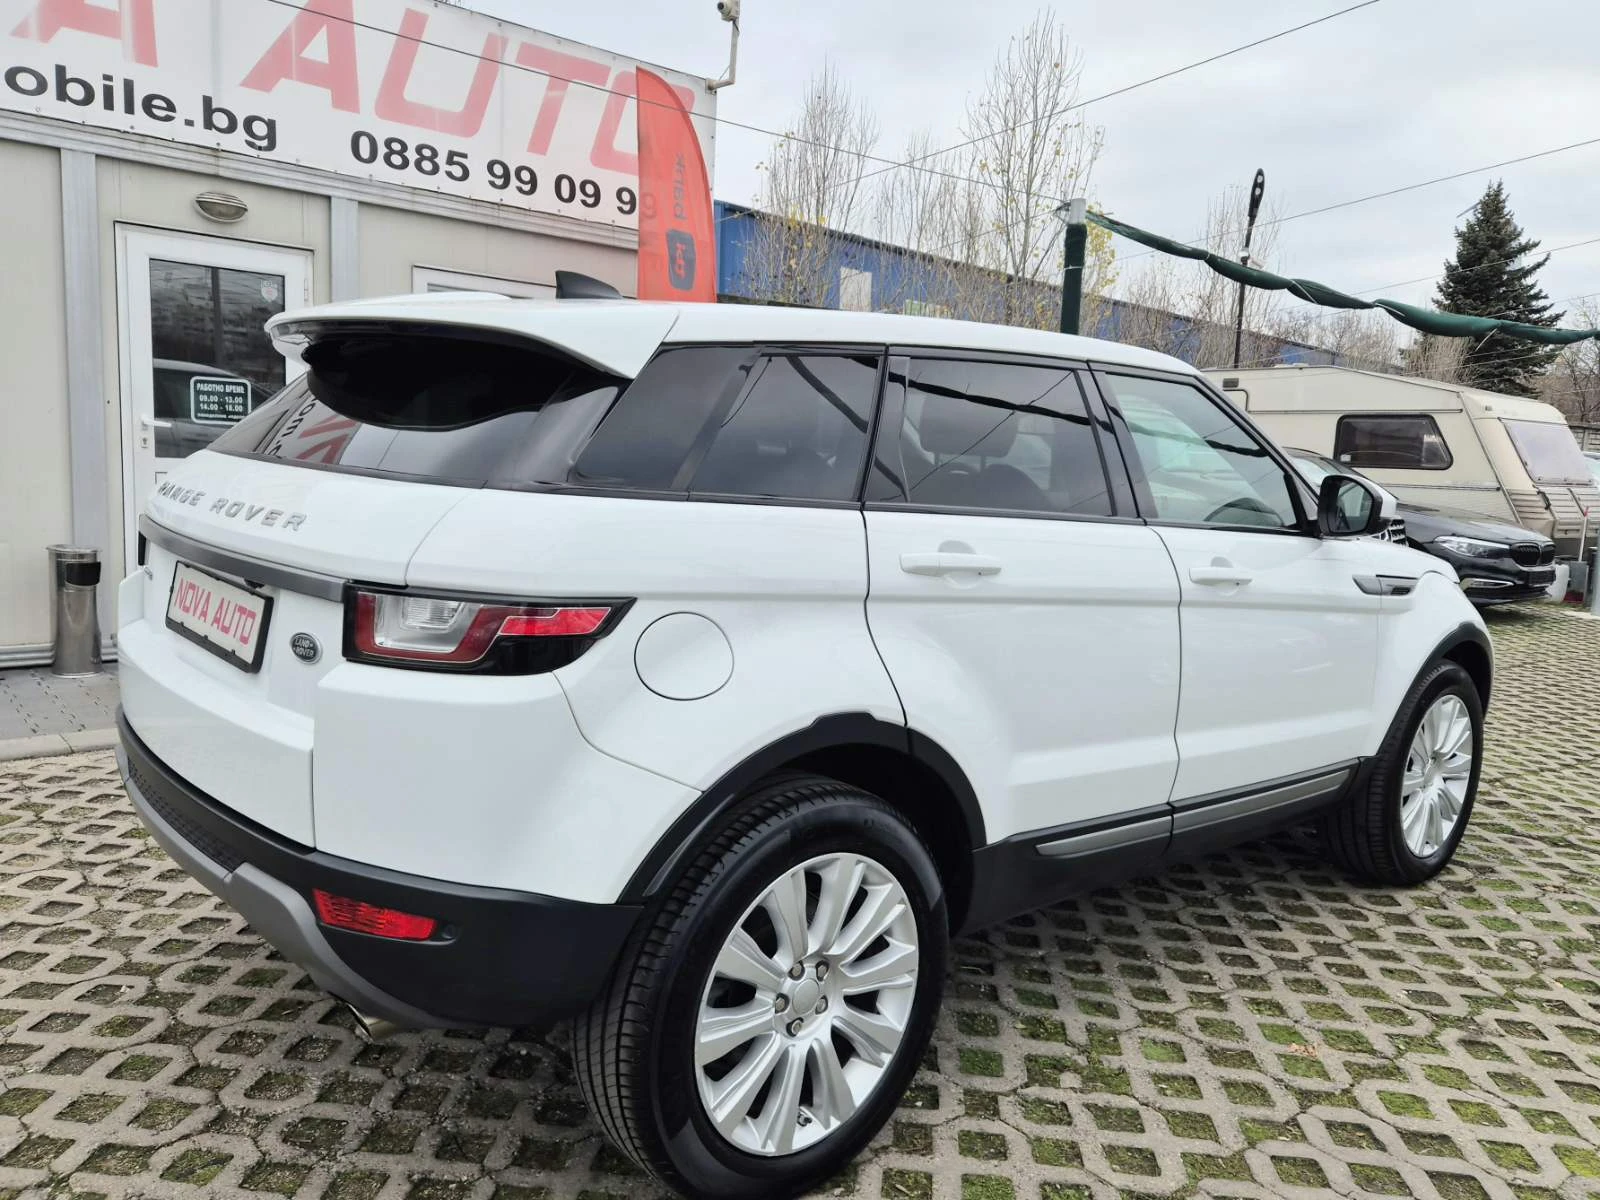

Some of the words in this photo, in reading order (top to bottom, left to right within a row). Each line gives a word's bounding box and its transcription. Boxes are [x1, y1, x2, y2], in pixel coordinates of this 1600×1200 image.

[4, 64, 277, 151] obile.bg
[350, 131, 470, 181] 0885
[486, 159, 538, 196] 99
[554, 174, 602, 208] 09
[158, 481, 206, 506] RANGE
[209, 498, 307, 531] ROVER
[174, 577, 212, 624] NOVA
[210, 596, 257, 645] AUTO
